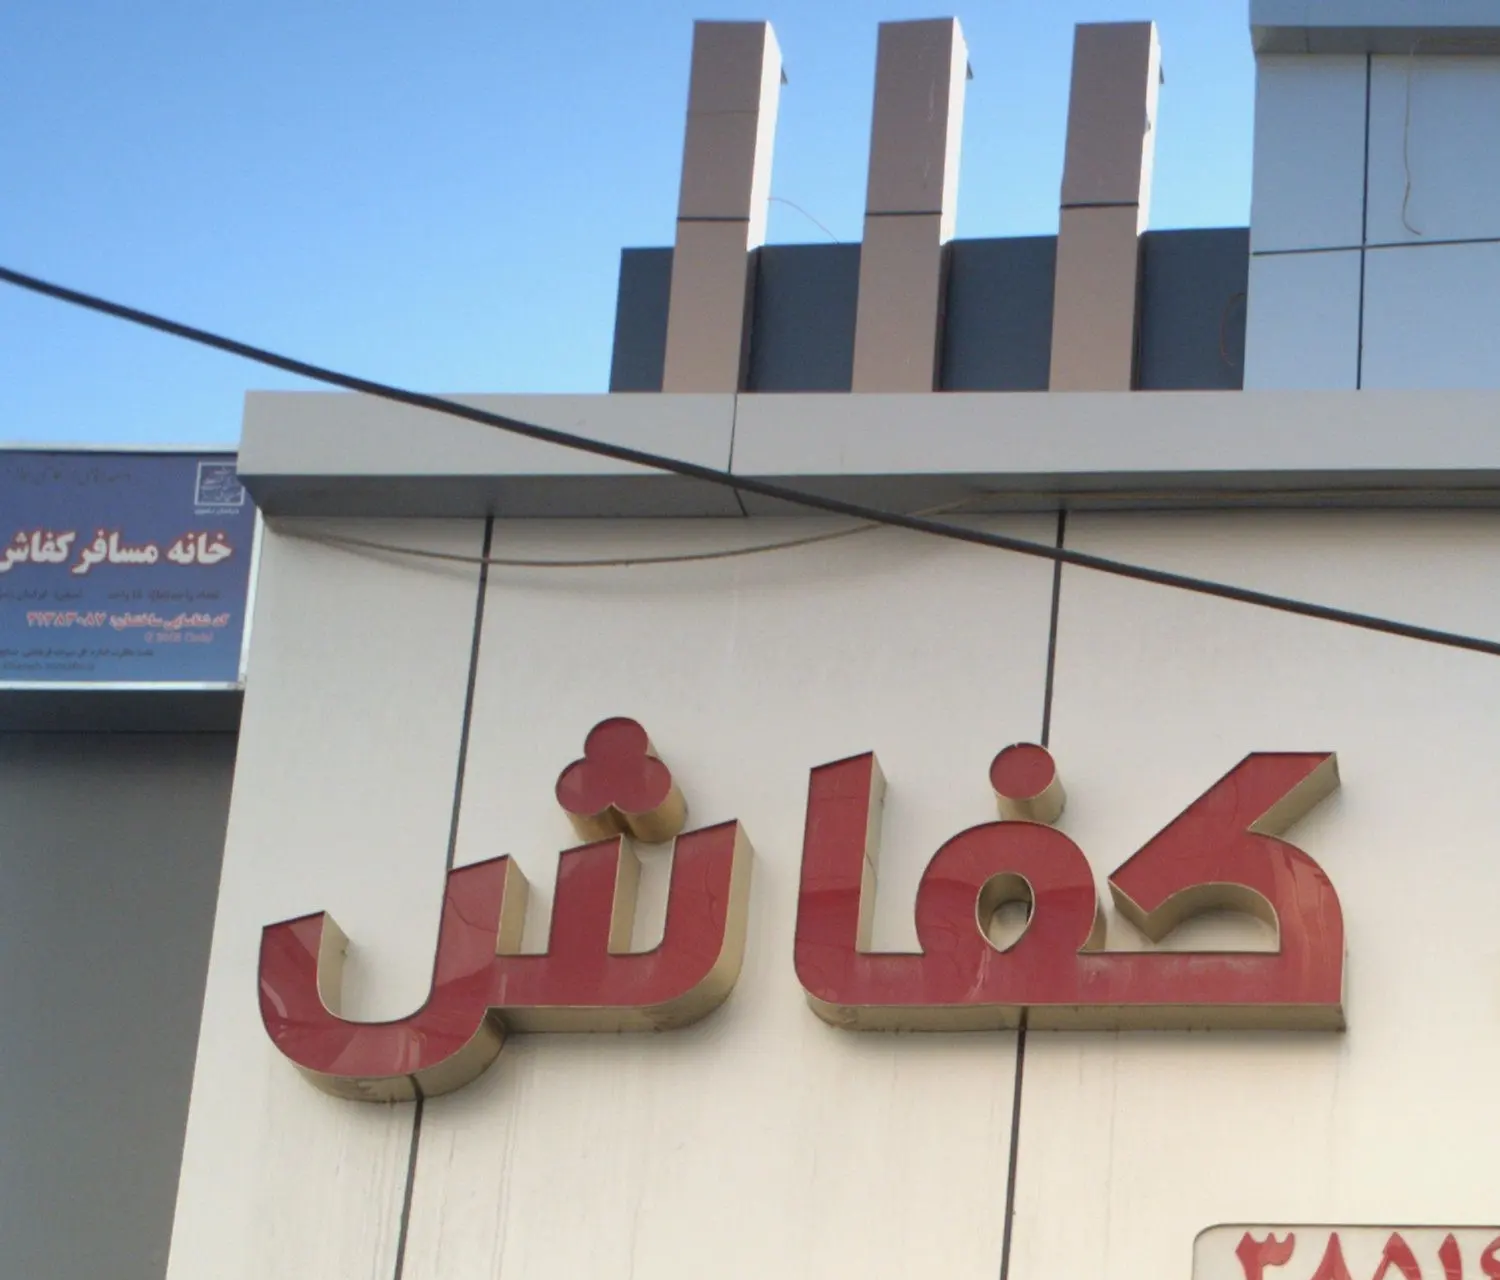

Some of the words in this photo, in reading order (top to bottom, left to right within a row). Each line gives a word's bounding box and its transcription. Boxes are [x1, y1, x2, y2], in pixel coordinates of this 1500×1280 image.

[0, 530, 76, 573] کفاش
[72, 529, 159, 574] مسافر
[167, 532, 232, 564] خانه
[257, 716, 1346, 1103] کفاش
